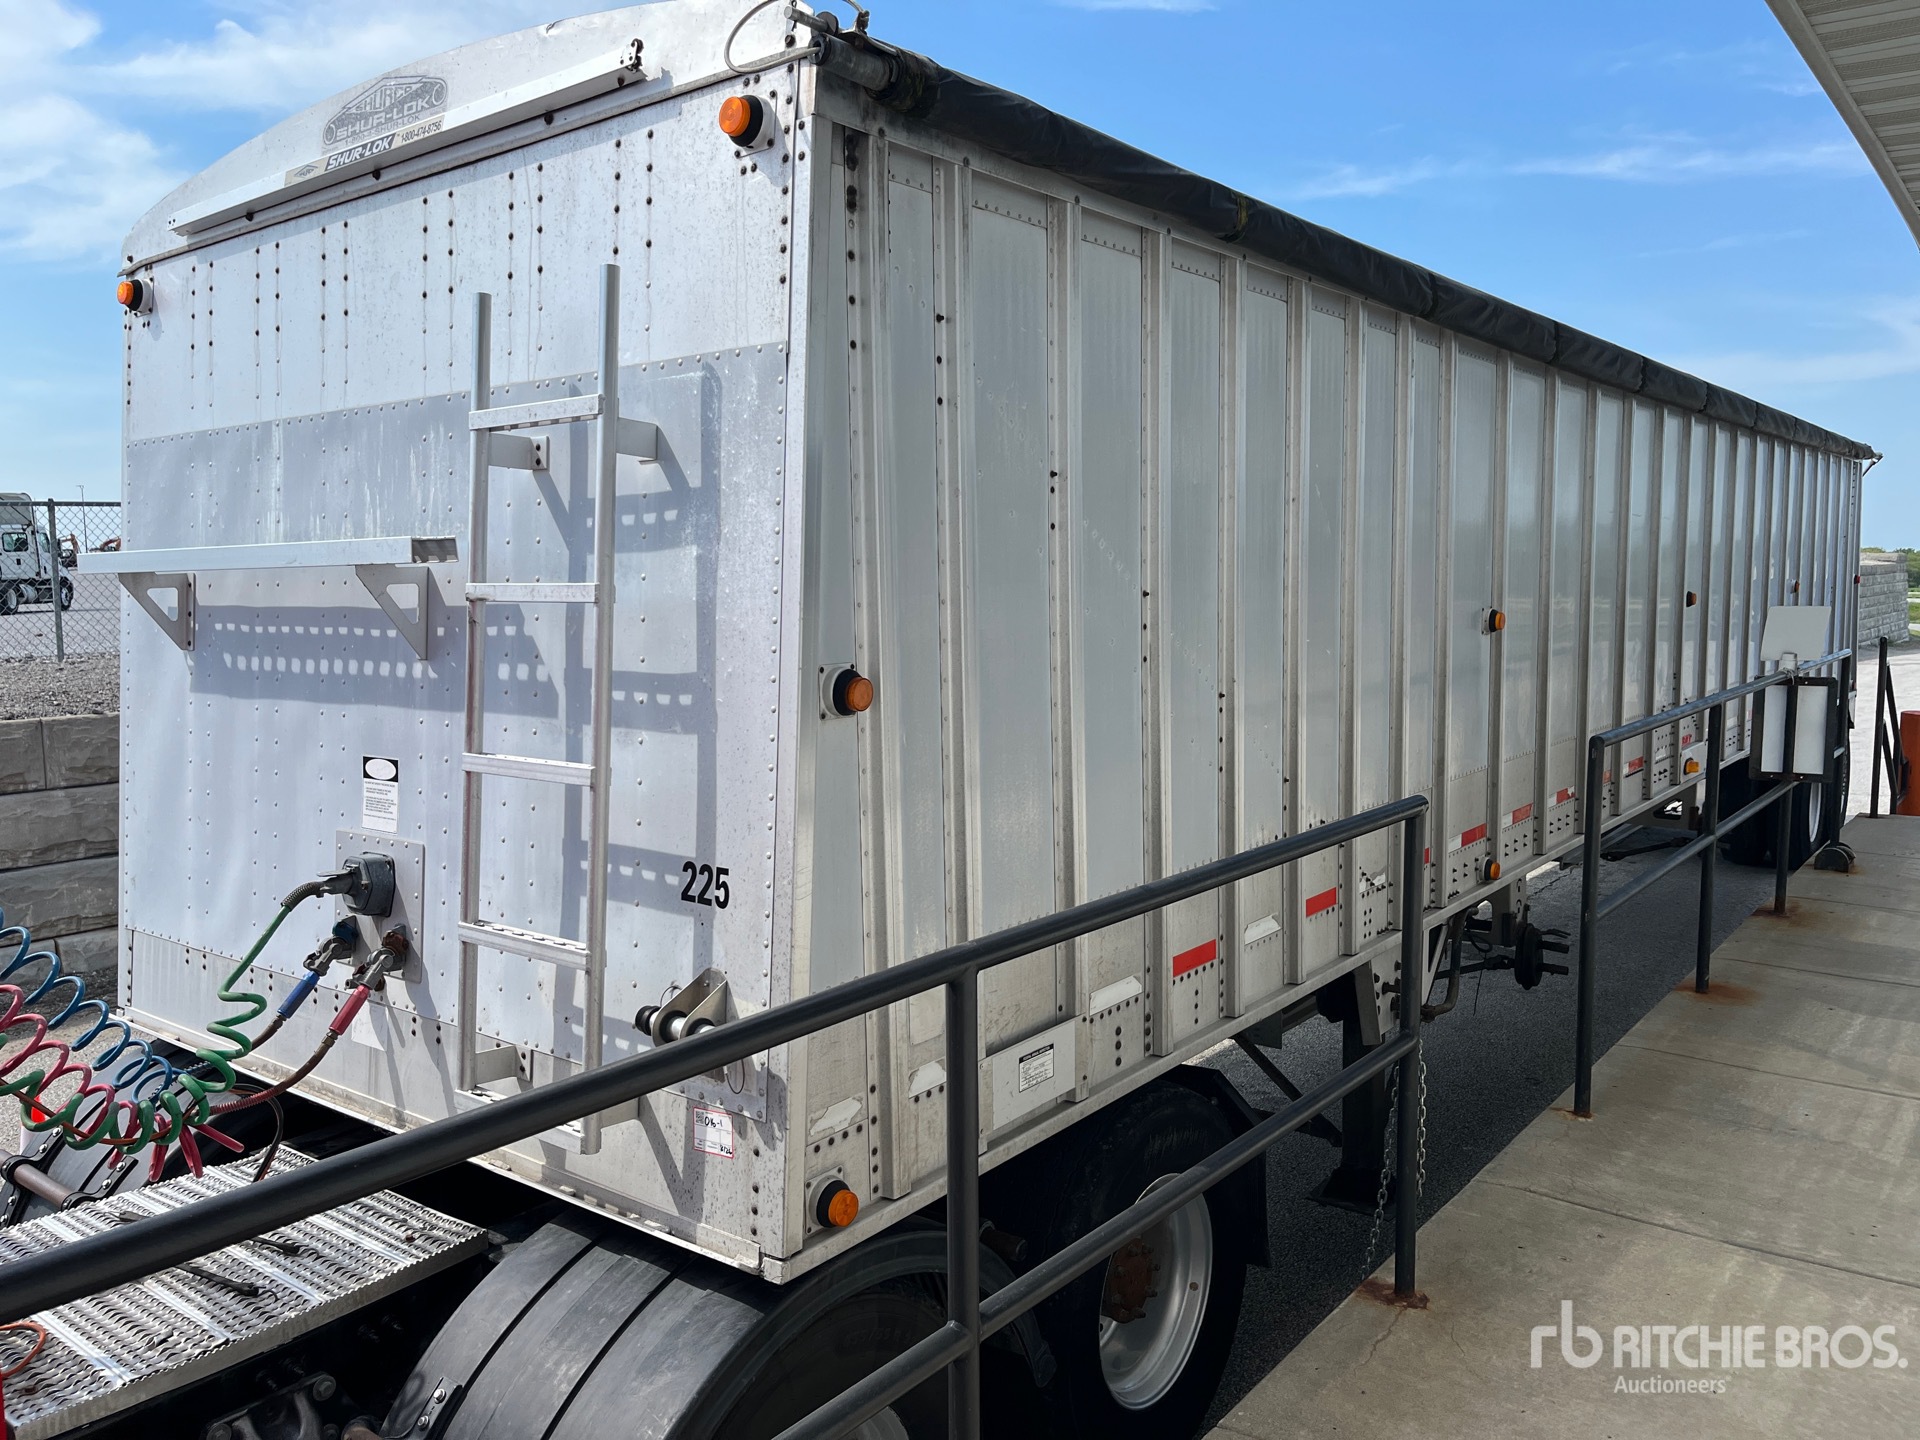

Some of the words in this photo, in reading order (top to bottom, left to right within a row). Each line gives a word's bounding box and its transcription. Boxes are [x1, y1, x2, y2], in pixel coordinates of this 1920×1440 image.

[336, 96, 430, 138] SHUR-LOK
[327, 135, 393, 169] SHUR-LOK
[681, 861, 729, 909] 225
